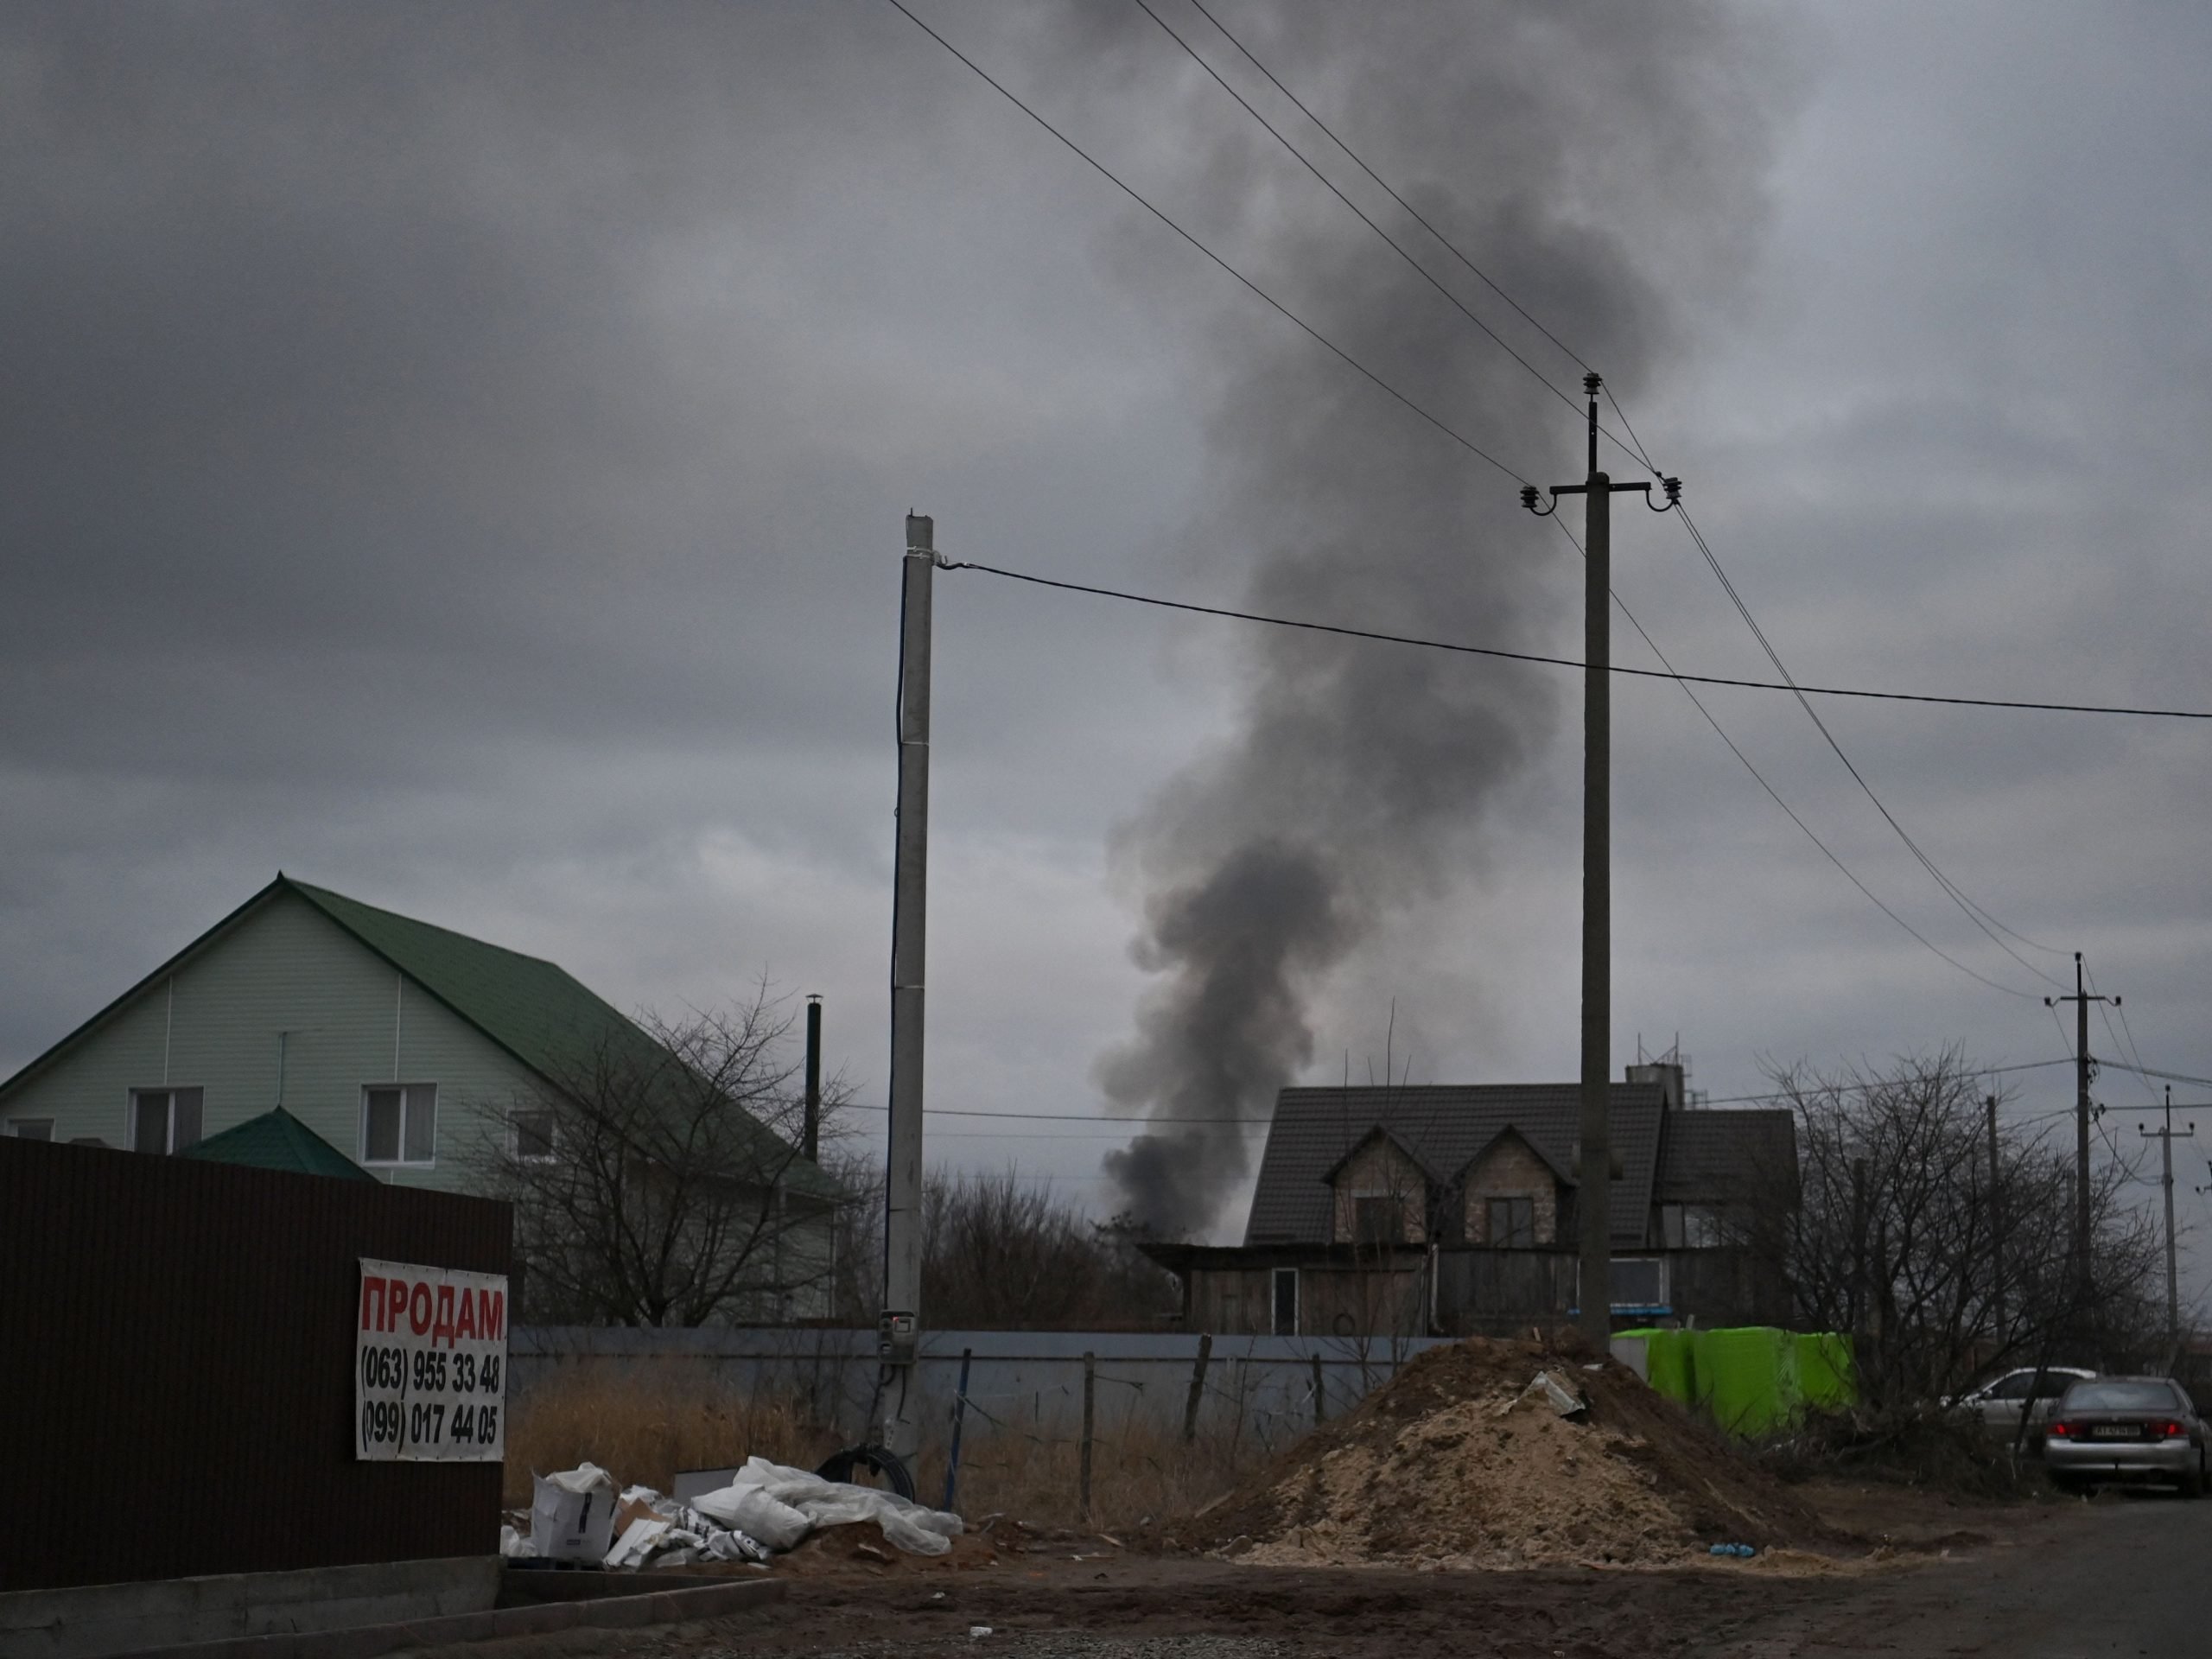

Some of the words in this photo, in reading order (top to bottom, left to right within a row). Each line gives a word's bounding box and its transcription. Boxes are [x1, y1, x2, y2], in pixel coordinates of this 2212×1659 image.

[362, 1275, 503, 1349] ПРОДАМ
[361, 1345, 408, 1400] (063)
[414, 1351, 447, 1392] 955
[452, 1353, 475, 1393] 33
[480, 1355, 500, 1394] 48
[362, 1401, 405, 1453] (099)
[411, 1402, 445, 1444] 017
[451, 1404, 474, 1444] 44
[478, 1405, 498, 1444] 05
